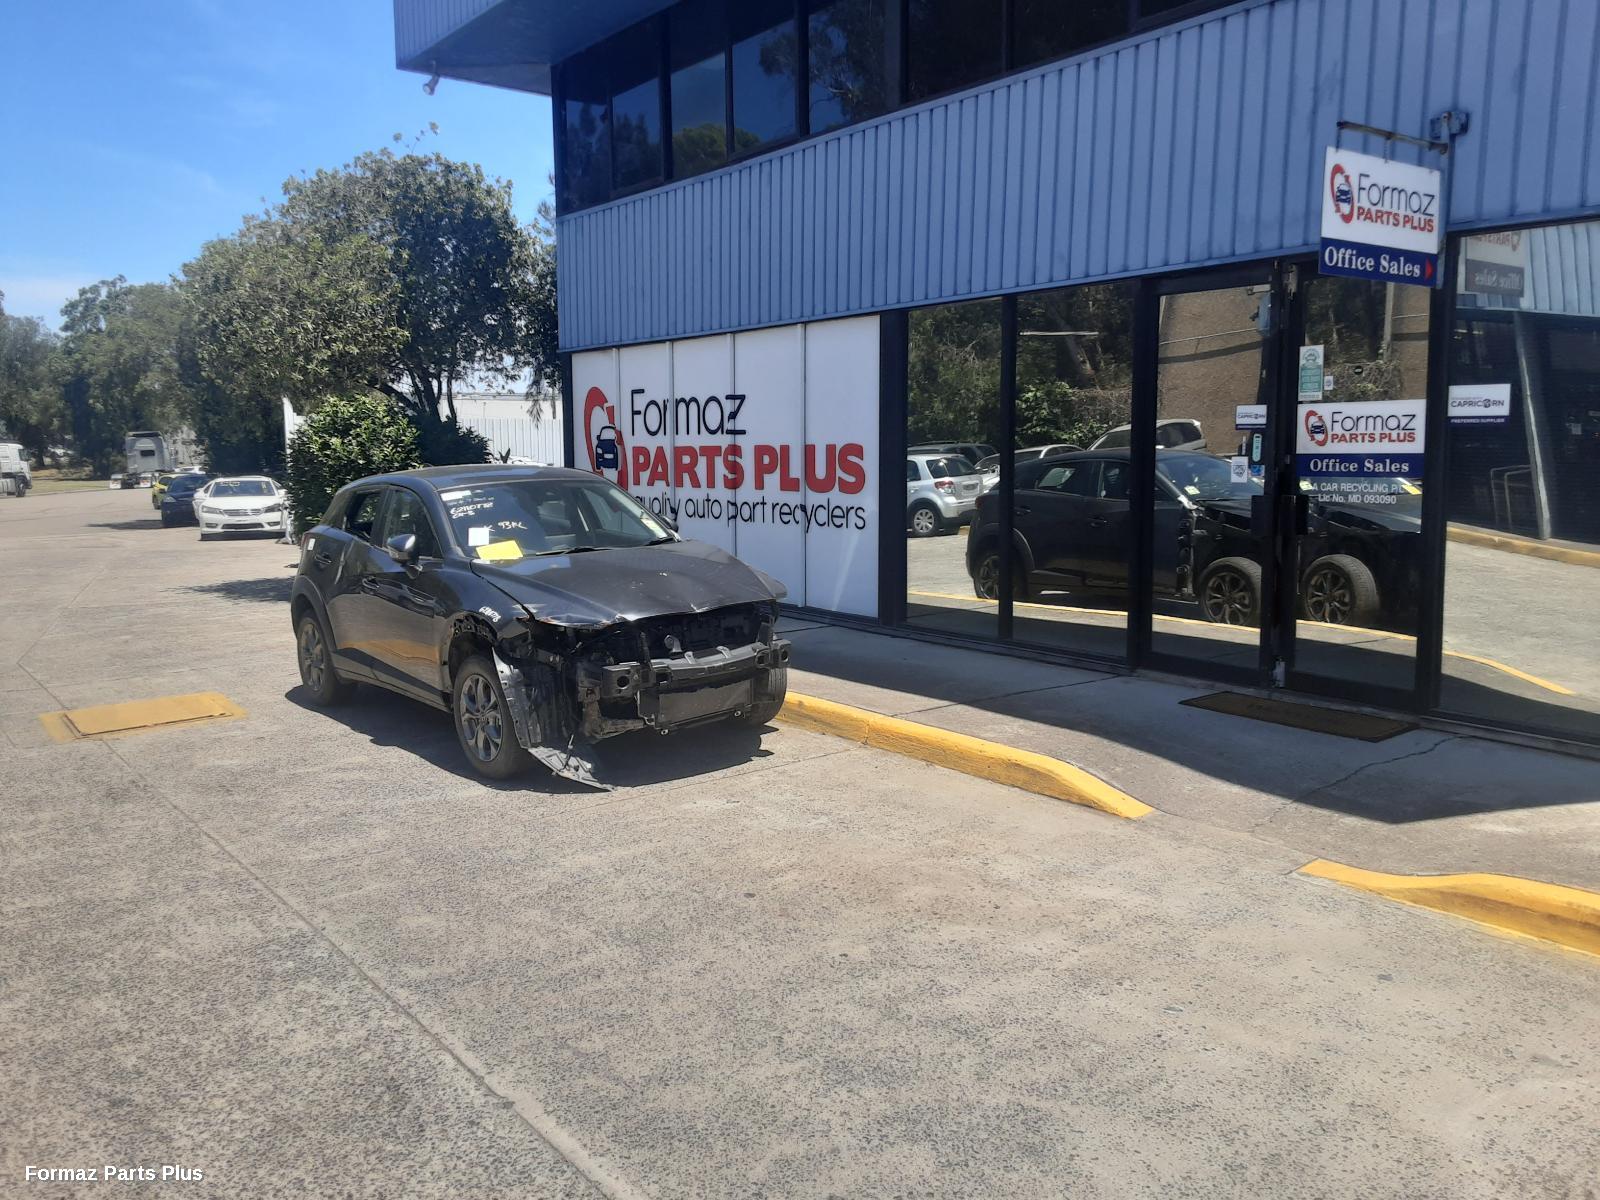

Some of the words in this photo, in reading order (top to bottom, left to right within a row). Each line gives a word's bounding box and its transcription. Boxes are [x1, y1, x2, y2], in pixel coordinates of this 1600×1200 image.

[1357, 173, 1436, 217] Formaz
[1356, 206, 1400, 227] PARTS
[1402, 216, 1434, 233] PLUS
[1324, 246, 1374, 271] Office
[1379, 254, 1421, 278] Sales
[631, 388, 747, 437] Formaz
[1331, 411, 1416, 432] Formaz
[1330, 432, 1376, 444] PARTS
[1378, 431, 1416, 443] PLUS
[632, 444, 745, 490] PARTS
[754, 443, 866, 495] PLUS
[1310, 458, 1358, 473] Office
[1364, 459, 1409, 473] Sales
[1318, 494, 1329, 502] Lic
[1332, 494, 1345, 503] No.
[1348, 495, 1362, 503] MD
[1364, 495, 1397, 504] 093090
[1320, 483, 1336, 491] CAR
[1340, 483, 1388, 493] RECYCLING
[685, 493, 722, 521] auto
[727, 495, 767, 528] part
[771, 498, 866, 534] recyclers
